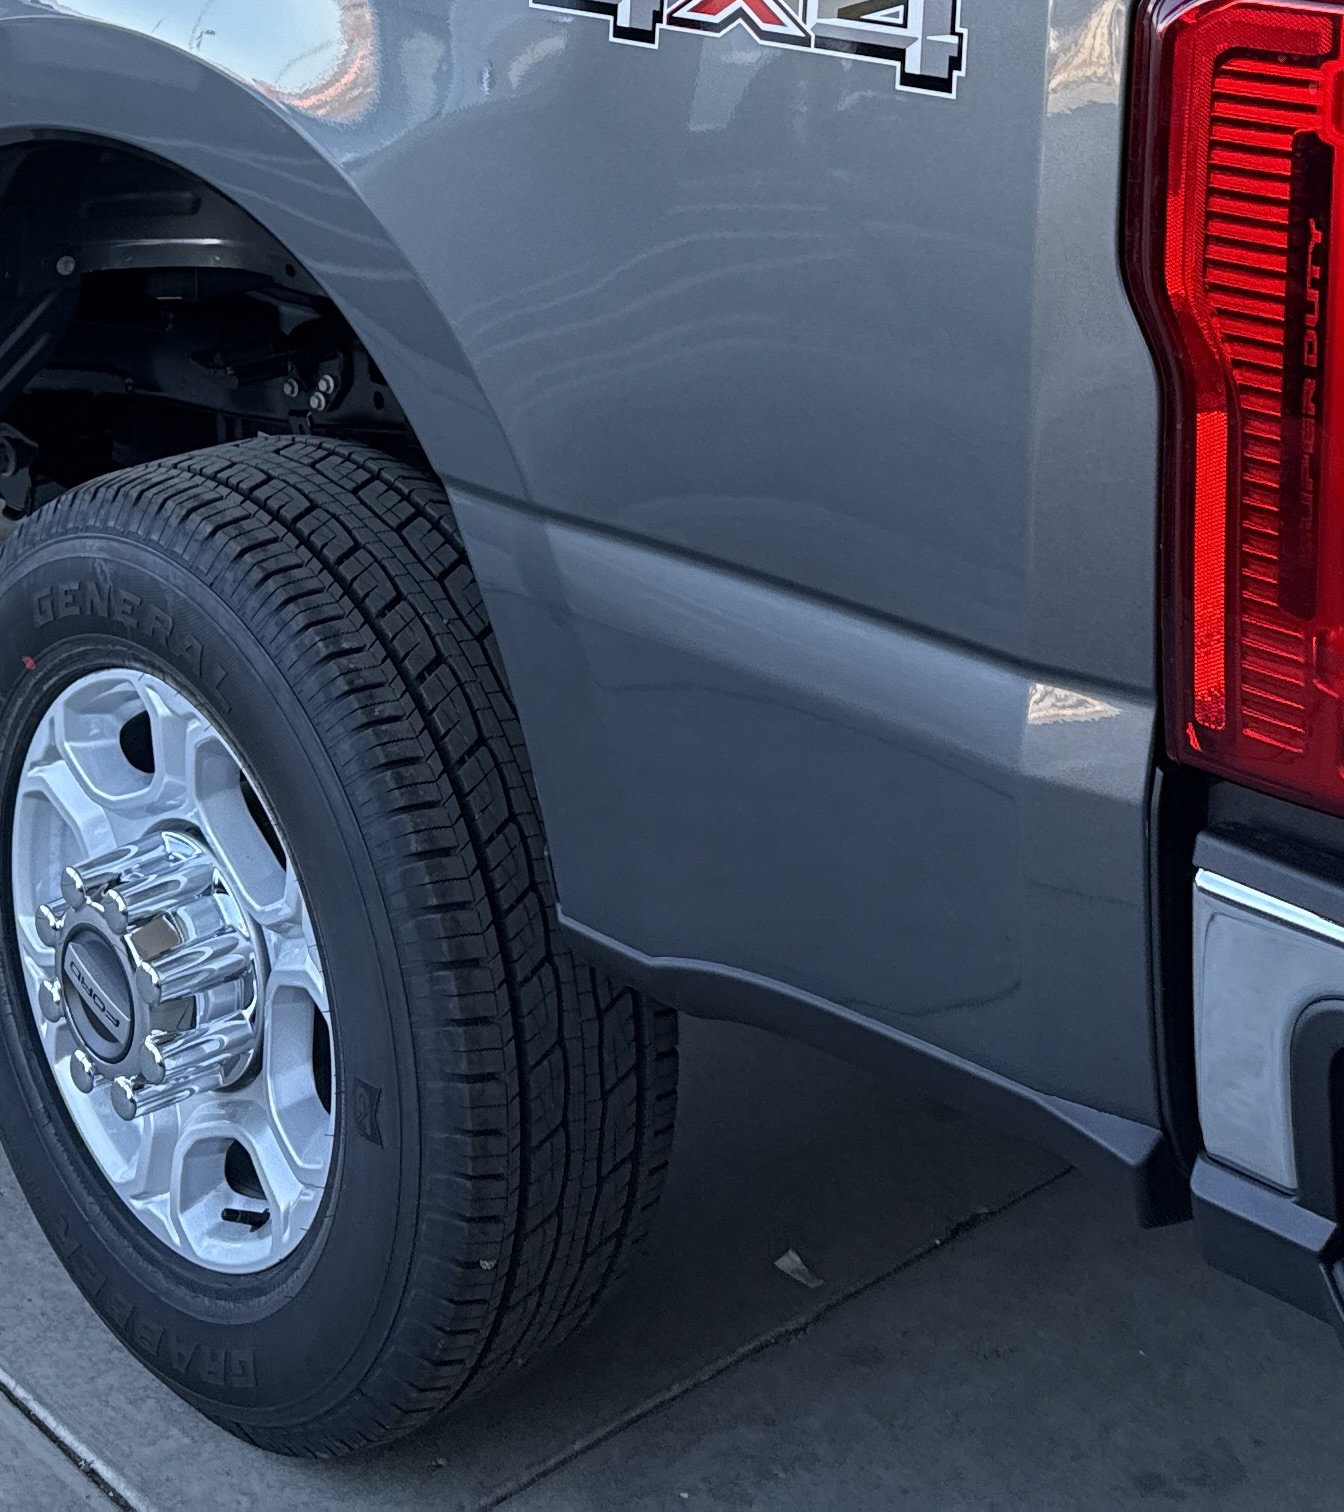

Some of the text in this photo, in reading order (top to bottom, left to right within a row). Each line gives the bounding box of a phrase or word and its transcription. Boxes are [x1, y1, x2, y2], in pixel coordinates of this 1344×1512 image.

[1301, 217, 1324, 370] DUTY
[32, 581, 233, 714] GENERAL
[69, 959, 121, 1029] FORD
